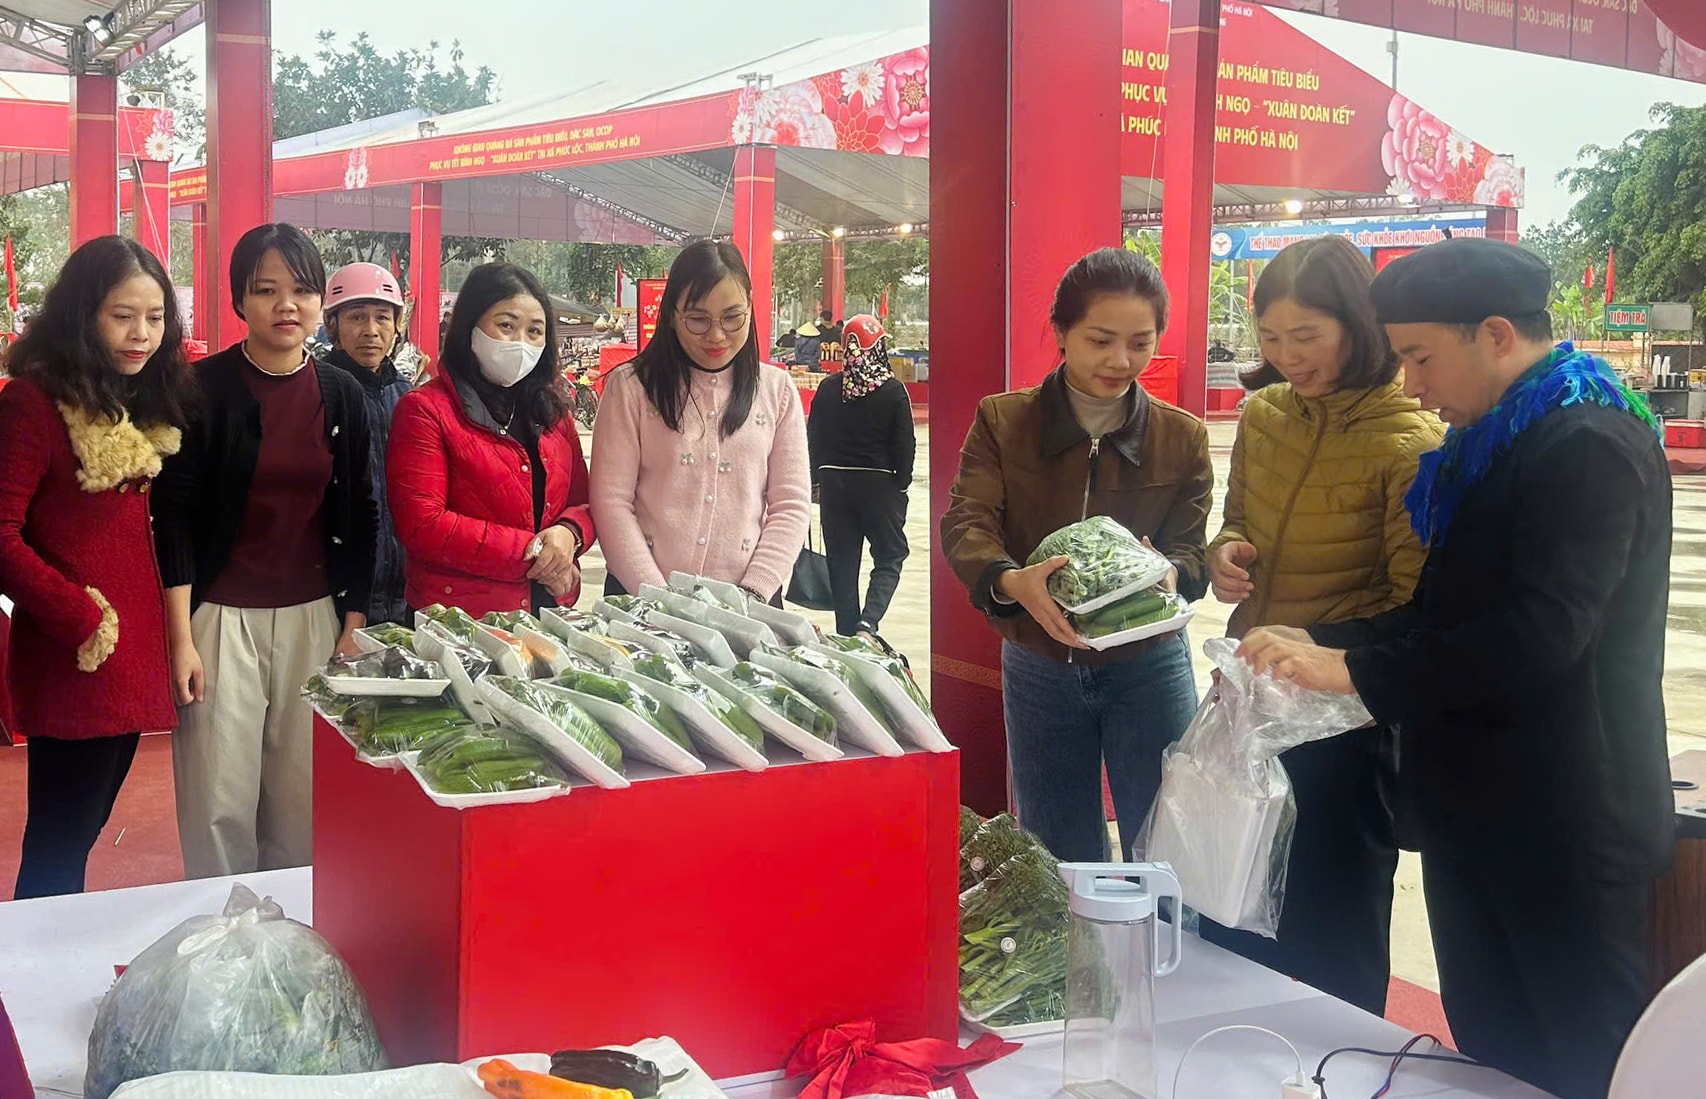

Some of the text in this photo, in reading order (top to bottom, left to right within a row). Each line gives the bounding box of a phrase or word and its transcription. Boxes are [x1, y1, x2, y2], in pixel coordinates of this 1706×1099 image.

[1122, 48, 1143, 68] IAN
[1217, 58, 1234, 79] ẢN
[1236, 60, 1268, 85] PHẨM
[1271, 68, 1293, 88] TIÊU
[1296, 67, 1320, 92] BIỂU
[1226, 95, 1251, 116] NGỌ
[1299, 102, 1330, 123] ĐOÀN
[596, 124, 613, 137] OCOP
[1128, 115, 1161, 136] PHÚC
[1233, 125, 1260, 146] PHỐ
[1260, 130, 1276, 149] HÀ
[1279, 132, 1299, 152] NỘI
[1609, 308, 1647, 327] TIỆM TRÀ
